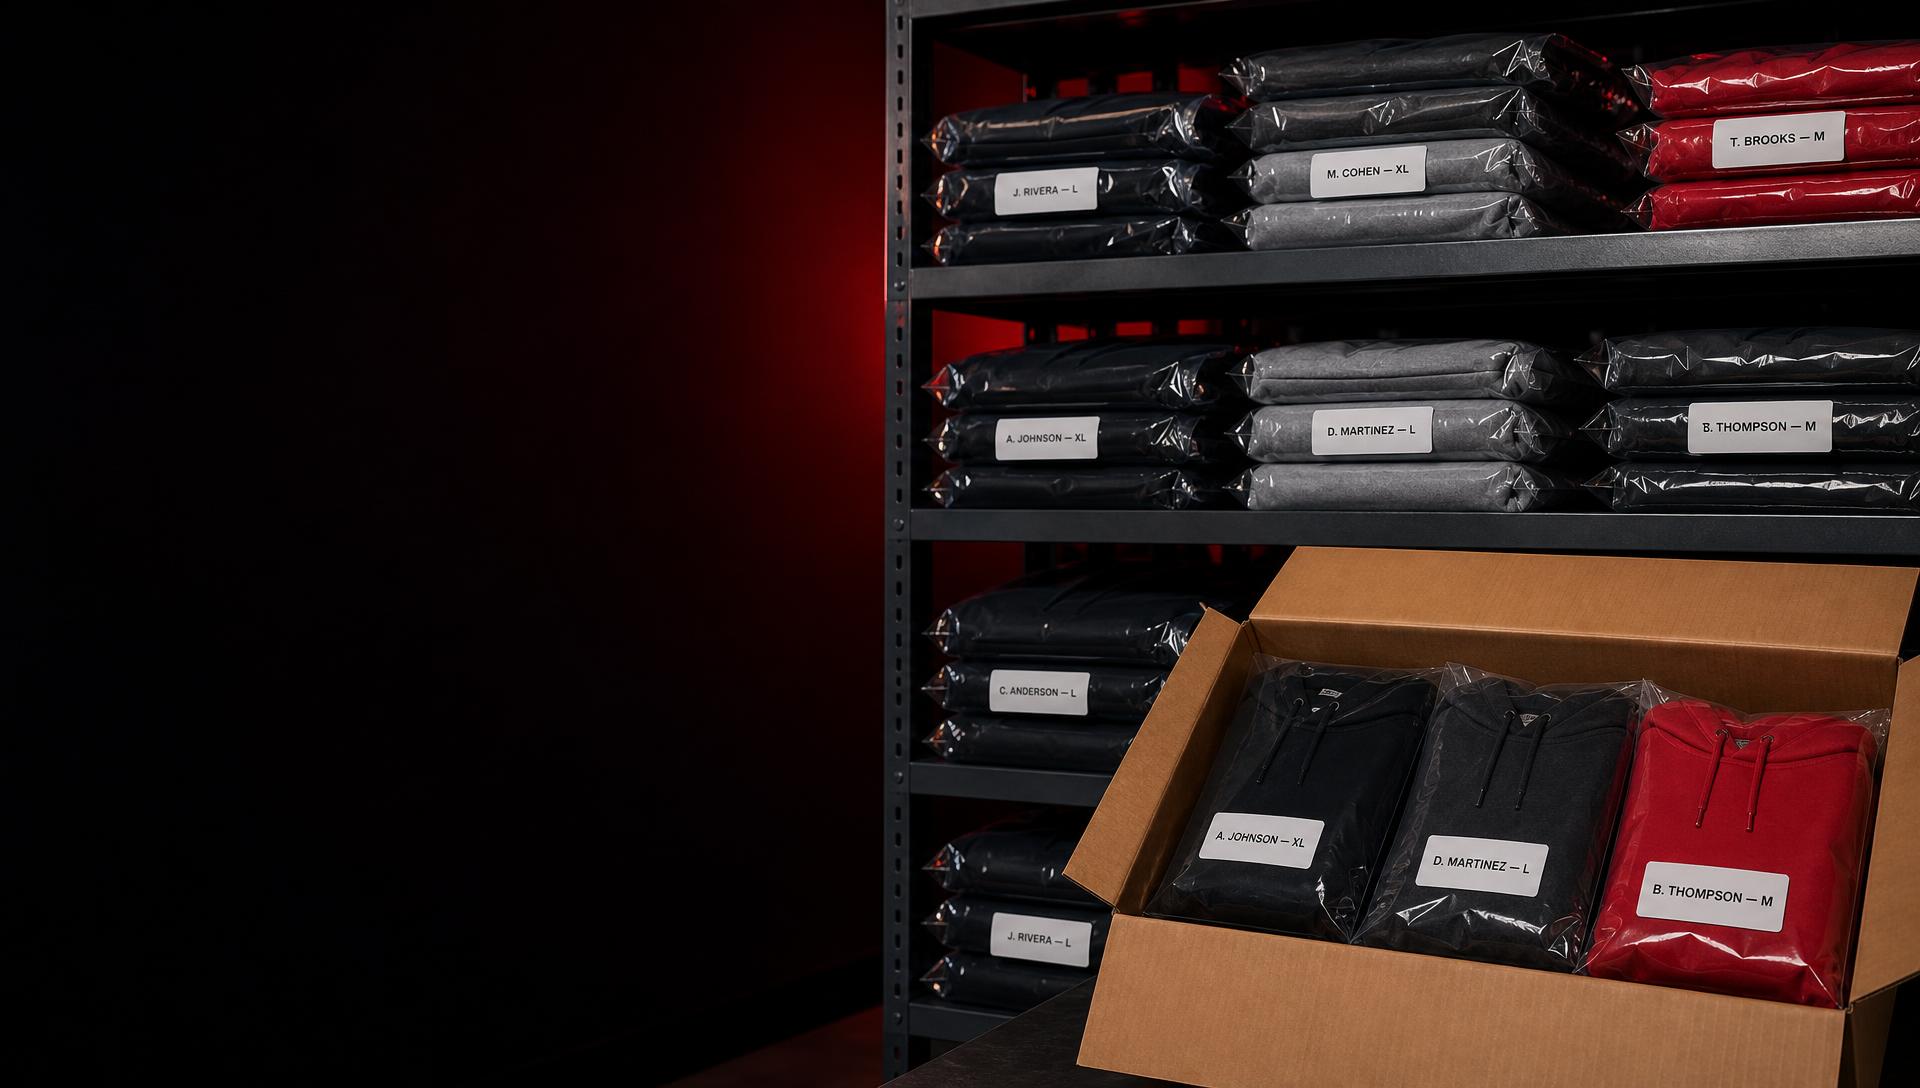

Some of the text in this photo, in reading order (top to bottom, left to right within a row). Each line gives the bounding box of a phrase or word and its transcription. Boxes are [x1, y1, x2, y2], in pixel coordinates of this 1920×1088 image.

[1730, 137, 1740, 147] T.
[1744, 133, 1796, 146] BROOKS
[1814, 131, 1825, 142] M
[1327, 169, 1339, 179] M.
[1342, 166, 1380, 178] COHEN
[1395, 164, 1409, 174] XL
[1013, 188, 1020, 197] J.
[1024, 186, 1058, 196] RIVERA
[1072, 185, 1078, 193] L
[1328, 427, 1338, 436] D.
[1340, 425, 1394, 436] MARTINEZ
[1410, 425, 1416, 434] L
[1716, 421, 1787, 432] THOMPSON
[1805, 421, 1816, 431] M
[1006, 435, 1015, 443] A.
[1017, 434, 1062, 443] JOHNSON
[1075, 433, 1086, 442] XL
[999, 686, 1008, 695] C.
[1010, 687, 1058, 696] ANDERSON
[1071, 689, 1077, 698] L
[1215, 831, 1225, 840] A.
[1227, 832, 1279, 844] JOHNSON
[1291, 837, 1305, 848] XL
[1433, 856, 1444, 866] D.
[1447, 857, 1507, 871] MARTINEZ
[1523, 863, 1530, 874] L
[1652, 884, 1664, 895] B.
[1668, 885, 1743, 903] THOMPSON
[1761, 895, 1773, 907] M
[1007, 932, 1015, 940] J.
[1018, 932, 1052, 945] RIVERA
[1065, 938, 1071, 948] L
